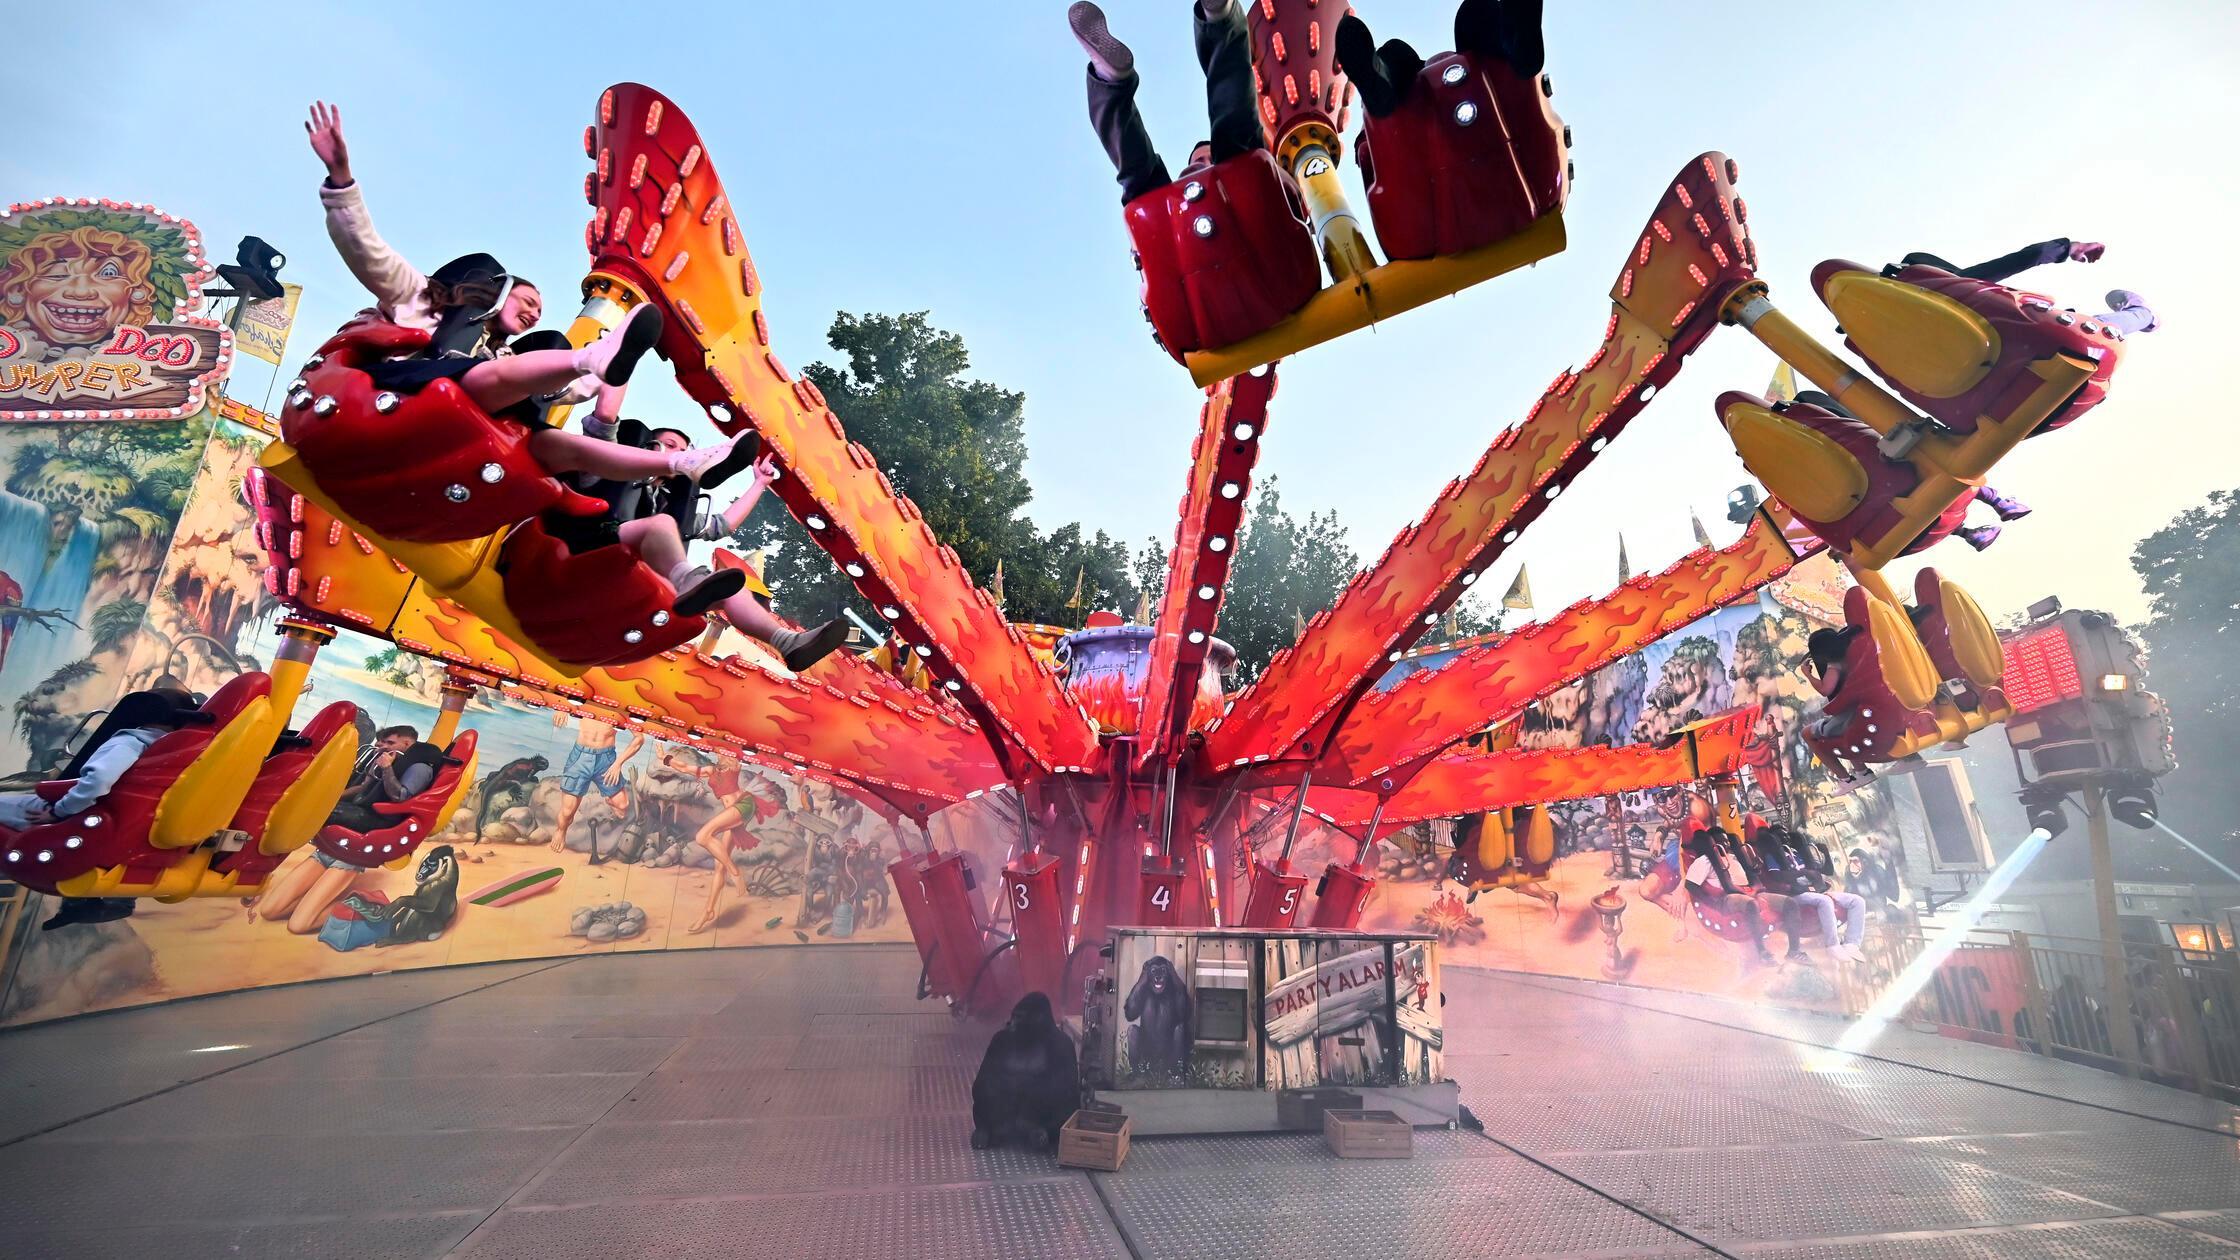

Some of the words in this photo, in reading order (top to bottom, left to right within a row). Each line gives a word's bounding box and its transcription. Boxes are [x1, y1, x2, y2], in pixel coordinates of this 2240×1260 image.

[1304, 158, 1329, 178] 4
[1015, 883, 1029, 910] 3
[1151, 885, 1170, 911] 4
[1279, 888, 1297, 914] 5
[1275, 975, 1331, 1015] PARTY
[1339, 958, 1407, 992] ALARM
